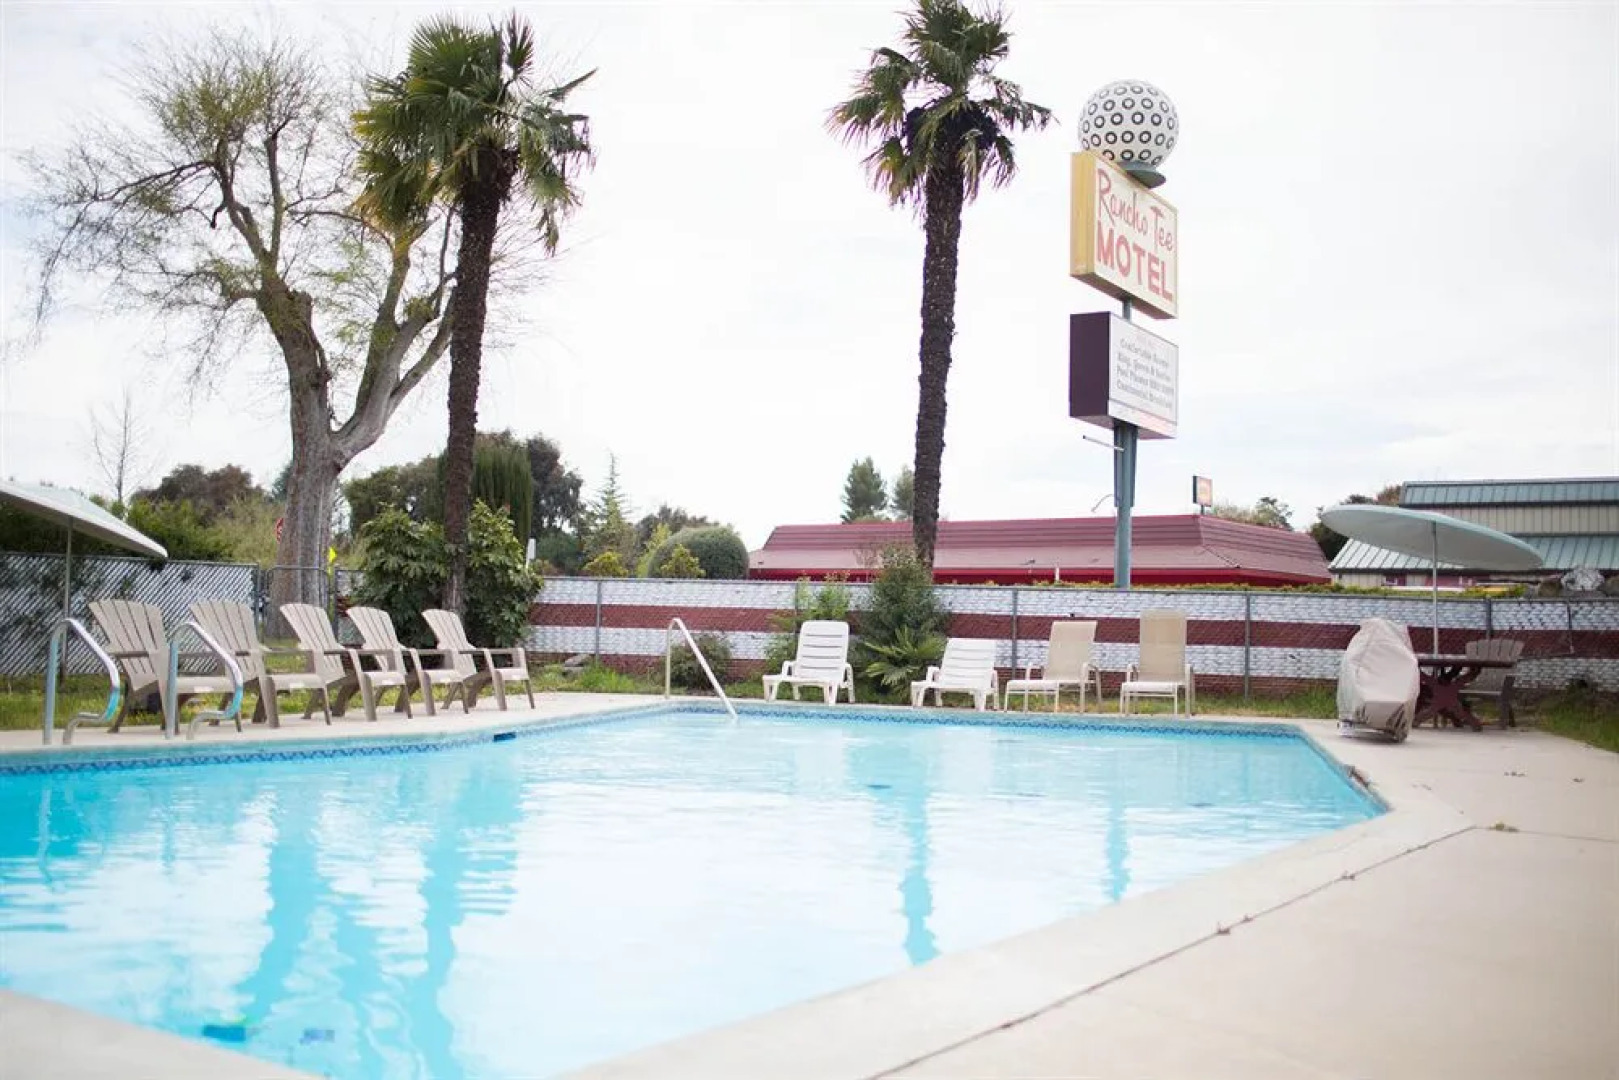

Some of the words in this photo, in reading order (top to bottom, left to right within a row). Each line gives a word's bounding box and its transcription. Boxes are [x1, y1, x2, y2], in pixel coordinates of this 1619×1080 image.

[1097, 168, 1148, 235] Rancho
[1151, 206, 1173, 251] Tee
[1097, 220, 1173, 302] MOTEL
